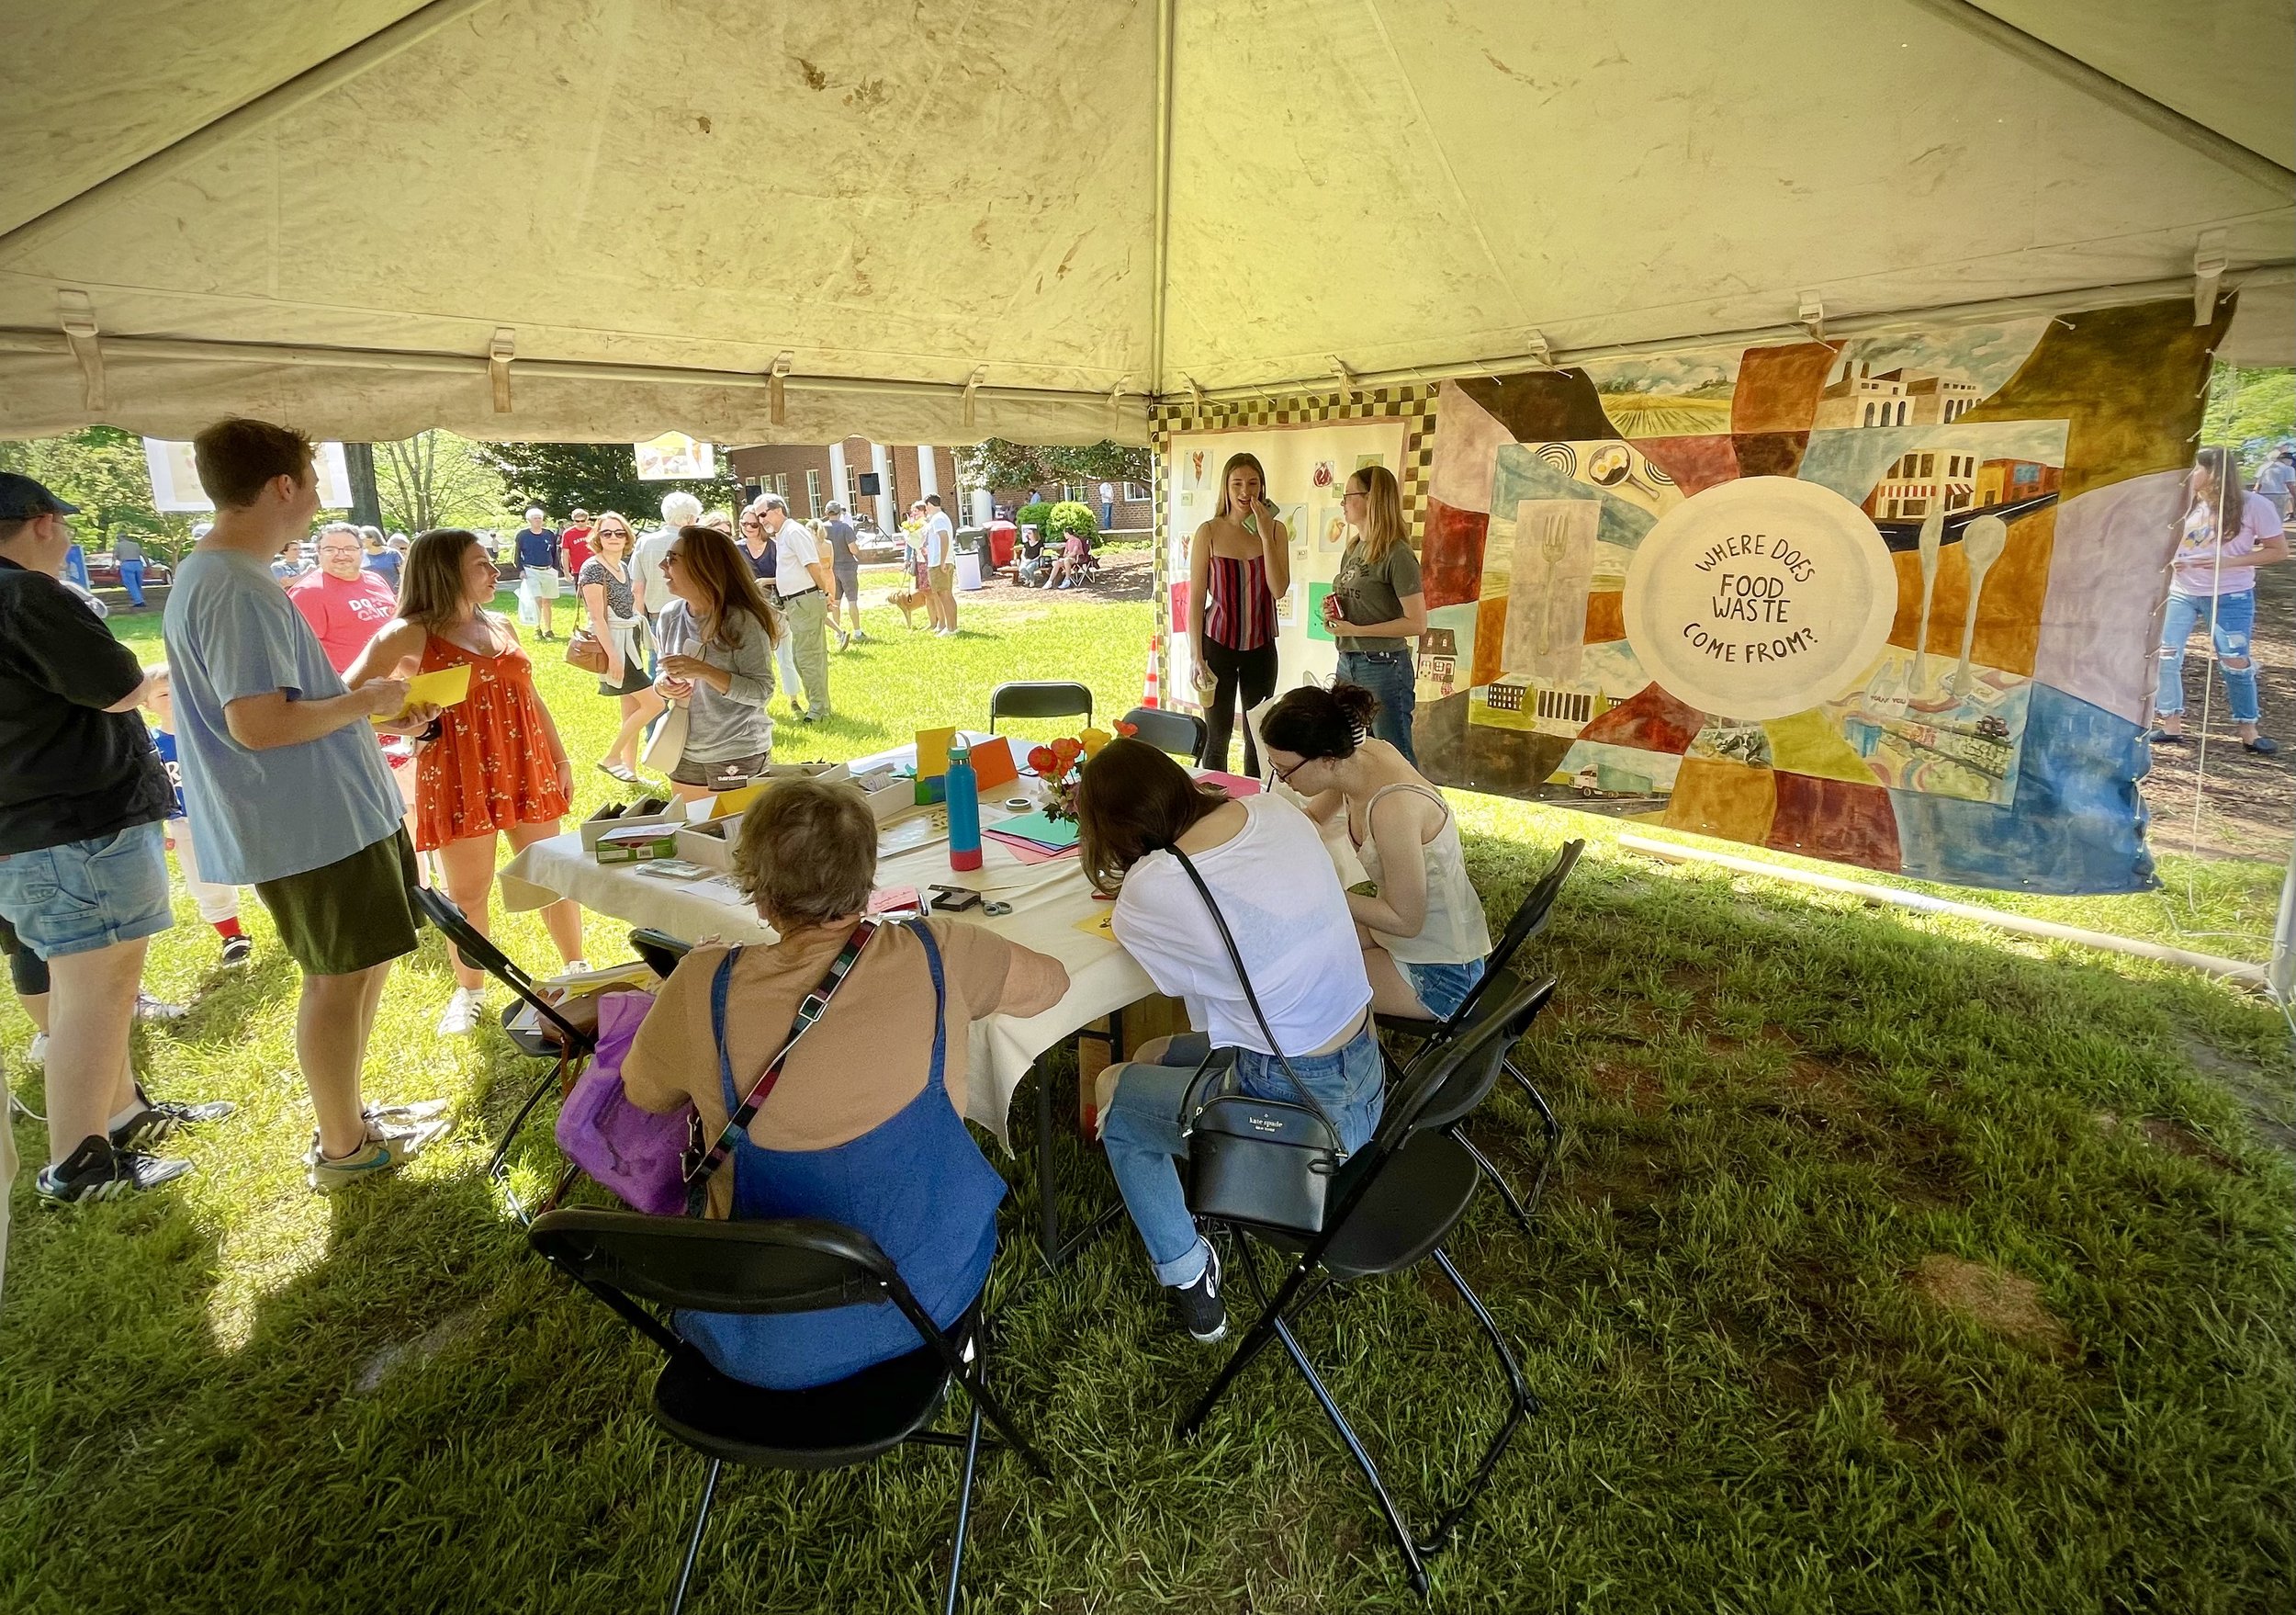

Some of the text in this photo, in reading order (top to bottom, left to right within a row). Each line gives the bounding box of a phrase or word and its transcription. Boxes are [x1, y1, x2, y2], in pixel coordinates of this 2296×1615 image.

[1694, 534, 1816, 582] WHERE DOES
[1720, 574, 1784, 599] FOOD
[1712, 596, 1791, 623] WASTE
[1683, 622, 1818, 663] COME FROM?
